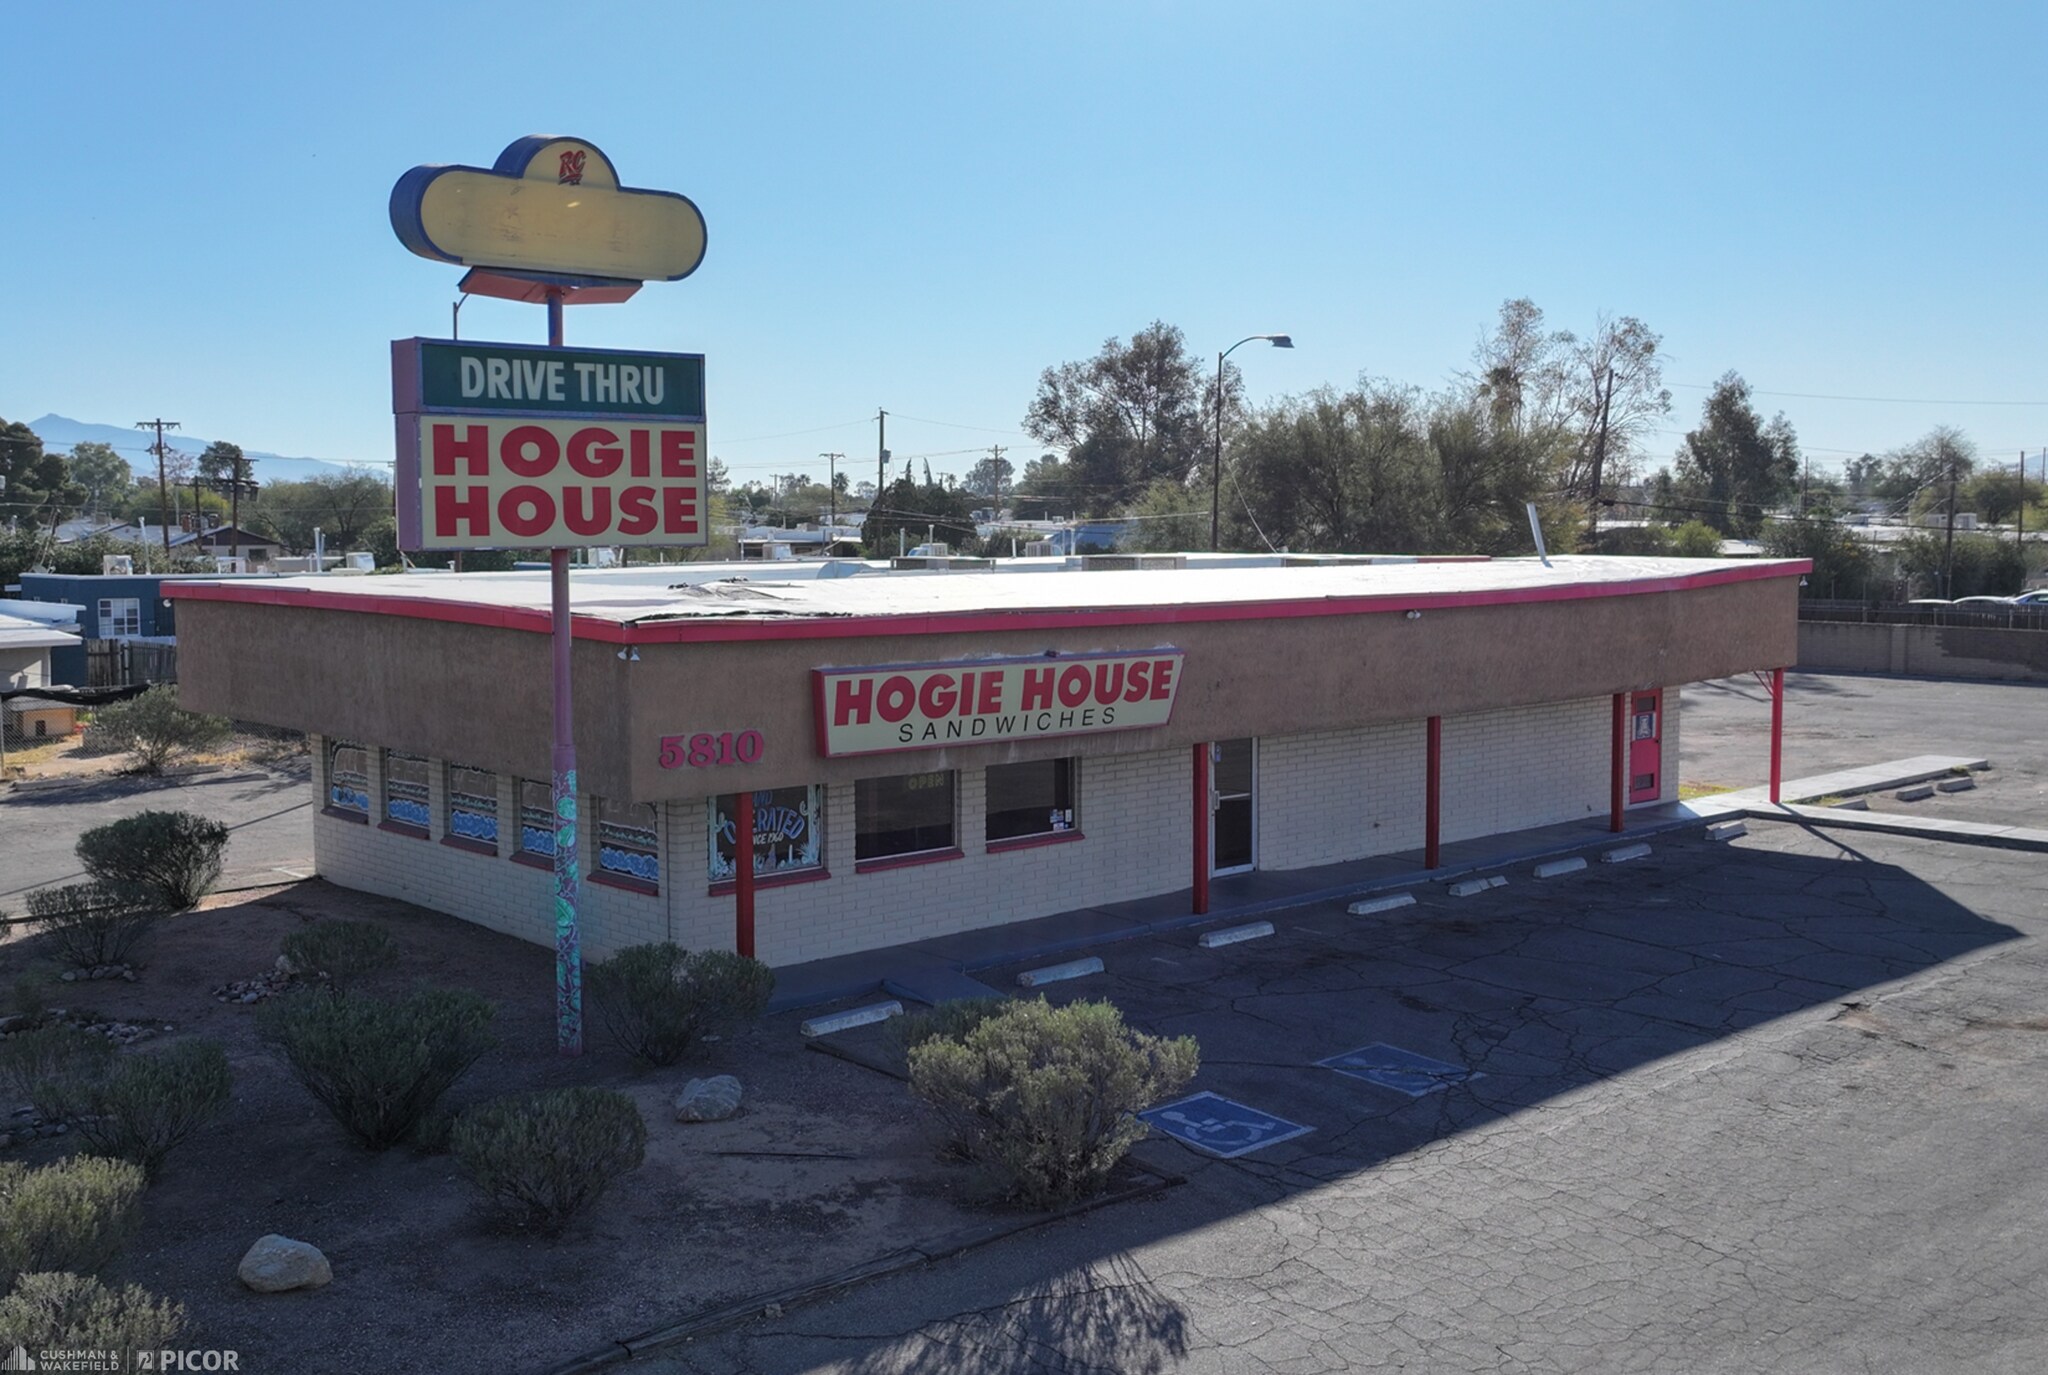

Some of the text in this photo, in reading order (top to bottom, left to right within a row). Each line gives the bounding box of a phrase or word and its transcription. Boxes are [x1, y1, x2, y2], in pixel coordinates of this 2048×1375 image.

[559, 150, 586, 176] RC
[461, 356, 664, 405] DRIVE THRU
[432, 424, 696, 478] HOGIE
[435, 485, 698, 537] HOUSE
[834, 660, 1174, 726] HOGIE HOUSE
[899, 707, 1115, 742] SANDWICHES
[659, 730, 764, 769] 5810
[909, 773, 944, 790] OPEN
